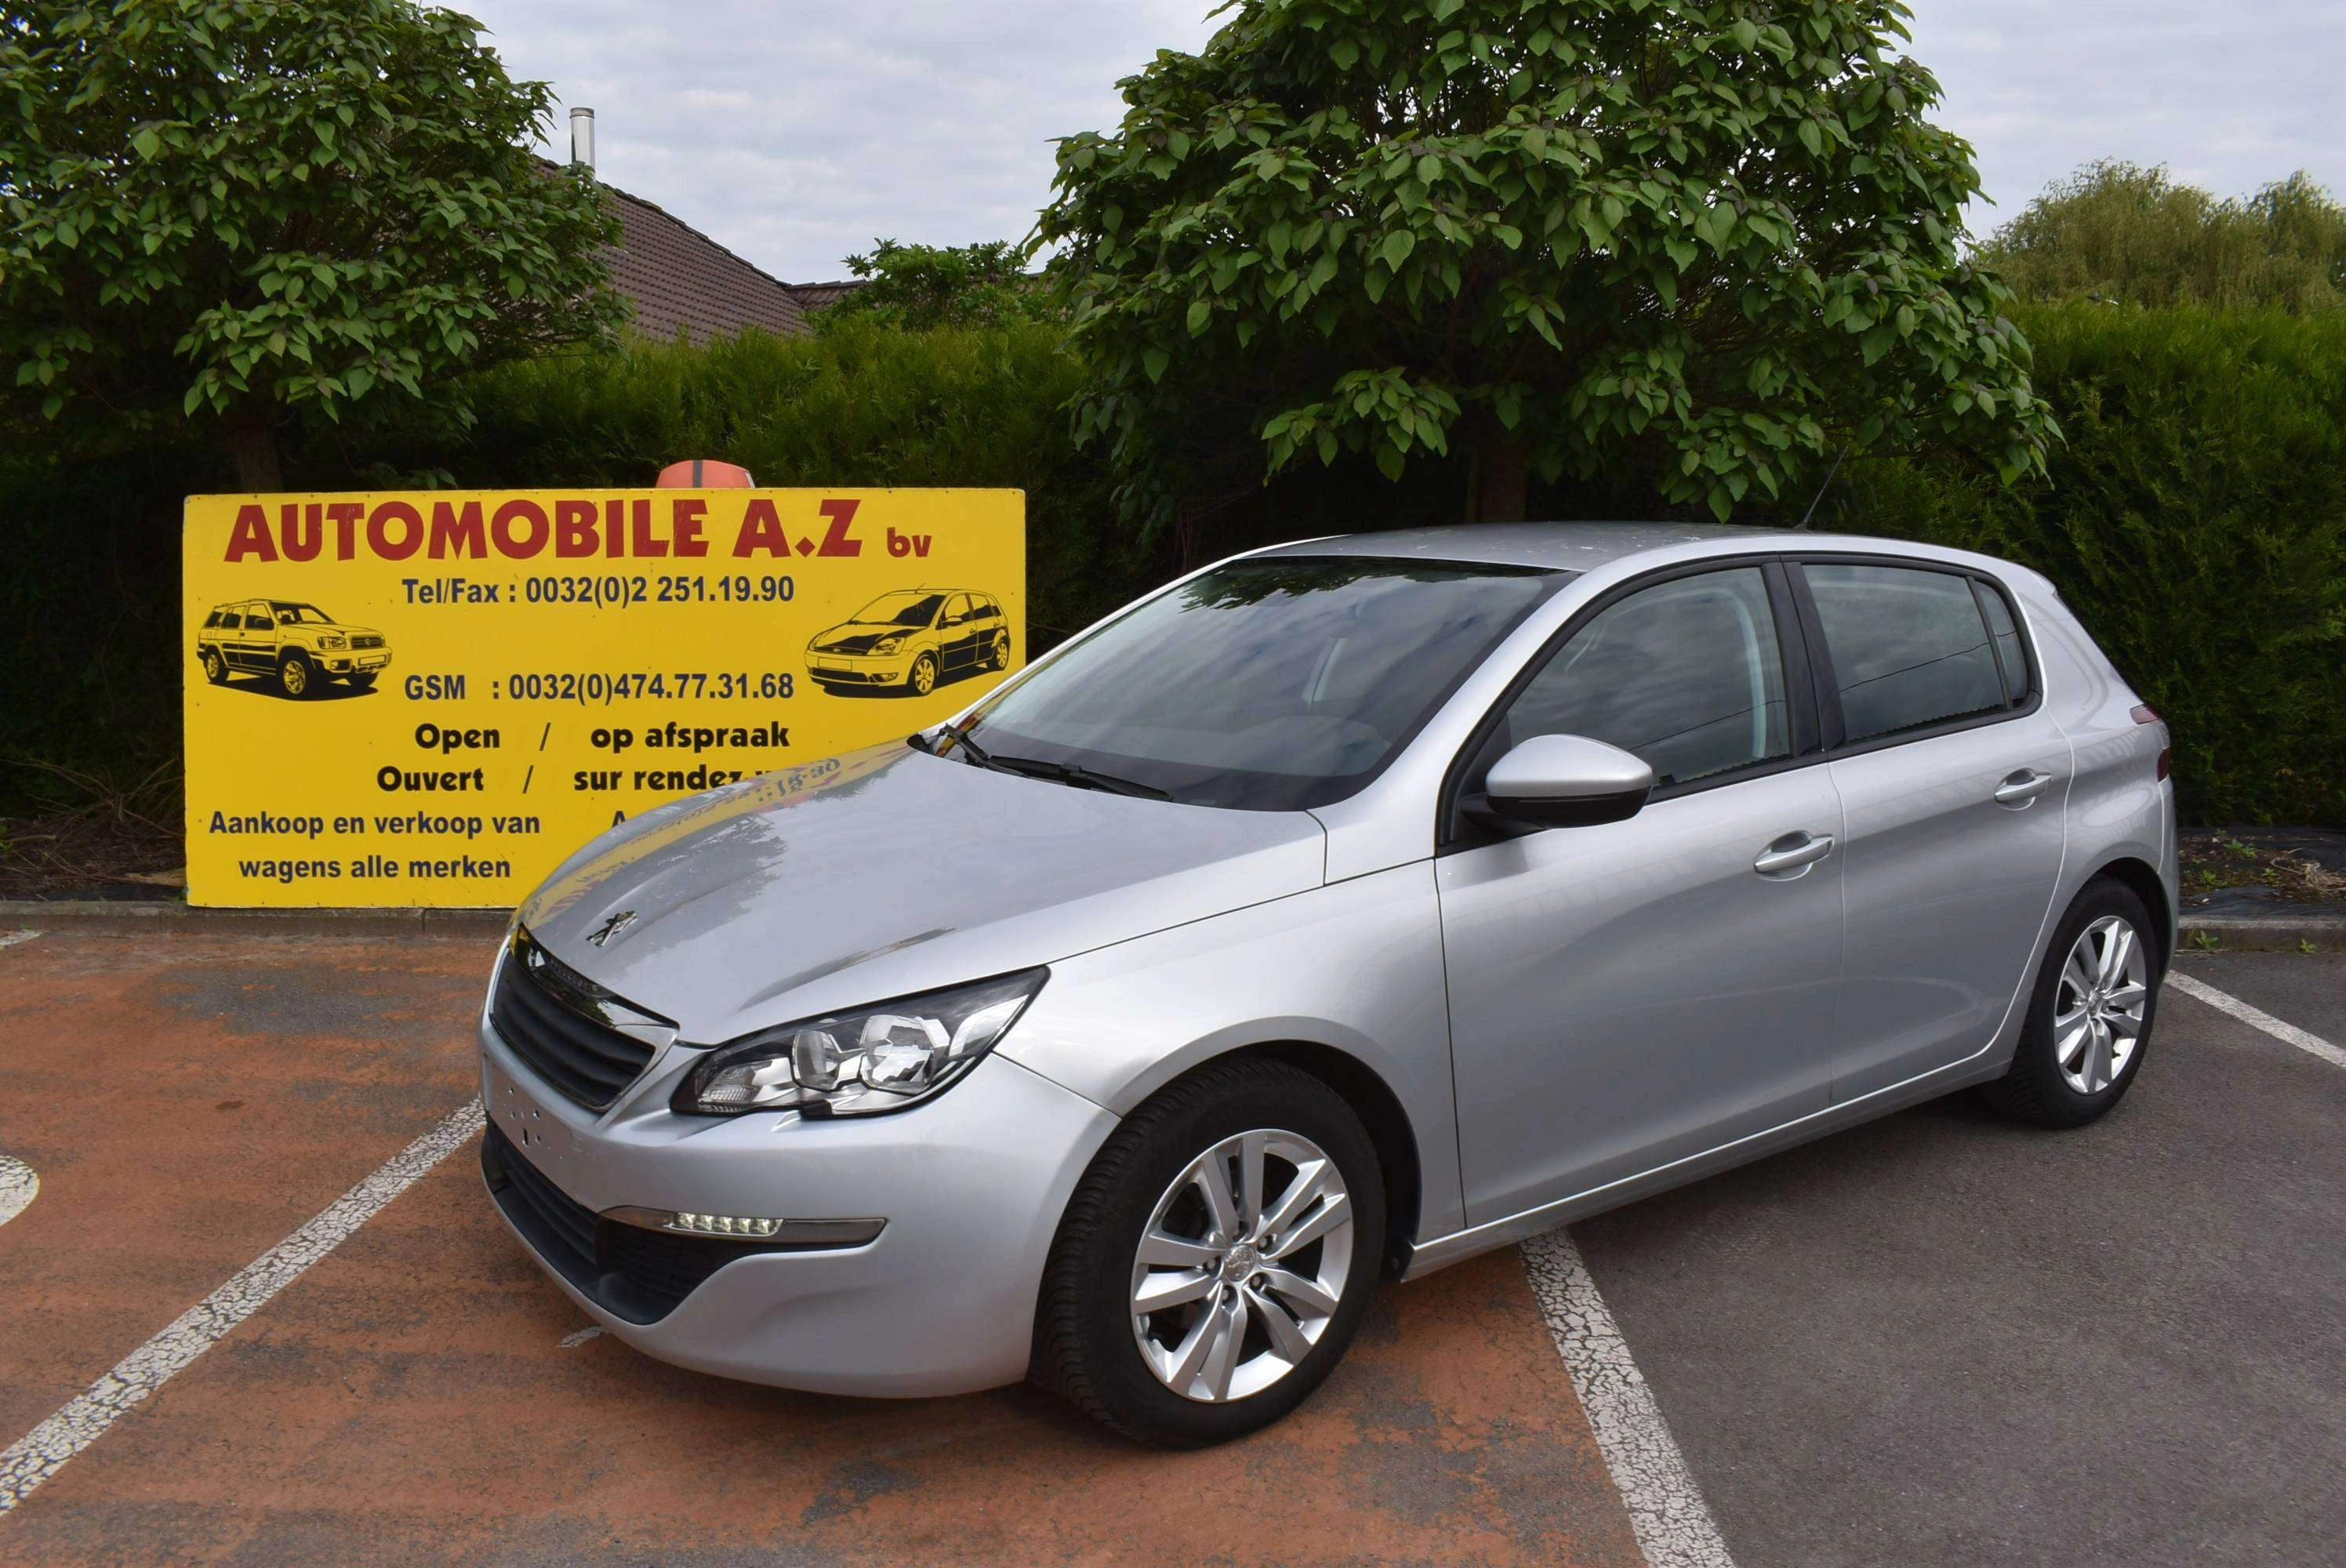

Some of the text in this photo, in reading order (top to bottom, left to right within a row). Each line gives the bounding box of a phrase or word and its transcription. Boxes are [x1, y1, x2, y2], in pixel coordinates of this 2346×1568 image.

[223, 499, 932, 563] AUTOMOBILE A.Z bv
[401, 578, 499, 604] Tel/Fax
[525, 576, 648, 609] 0032(0)2
[657, 575, 794, 602] 251.19.90
[404, 674, 466, 701] GSM
[509, 673, 794, 706] 0032(0)474.77.31.68
[415, 722, 500, 755] Open
[590, 728, 634, 754] op
[645, 720, 790, 754] afspraak
[376, 765, 485, 792] Ouvert
[573, 771, 623, 791] sur
[209, 810, 540, 840] Aankoop en verkoop van
[238, 855, 510, 884] wagens alle merken
